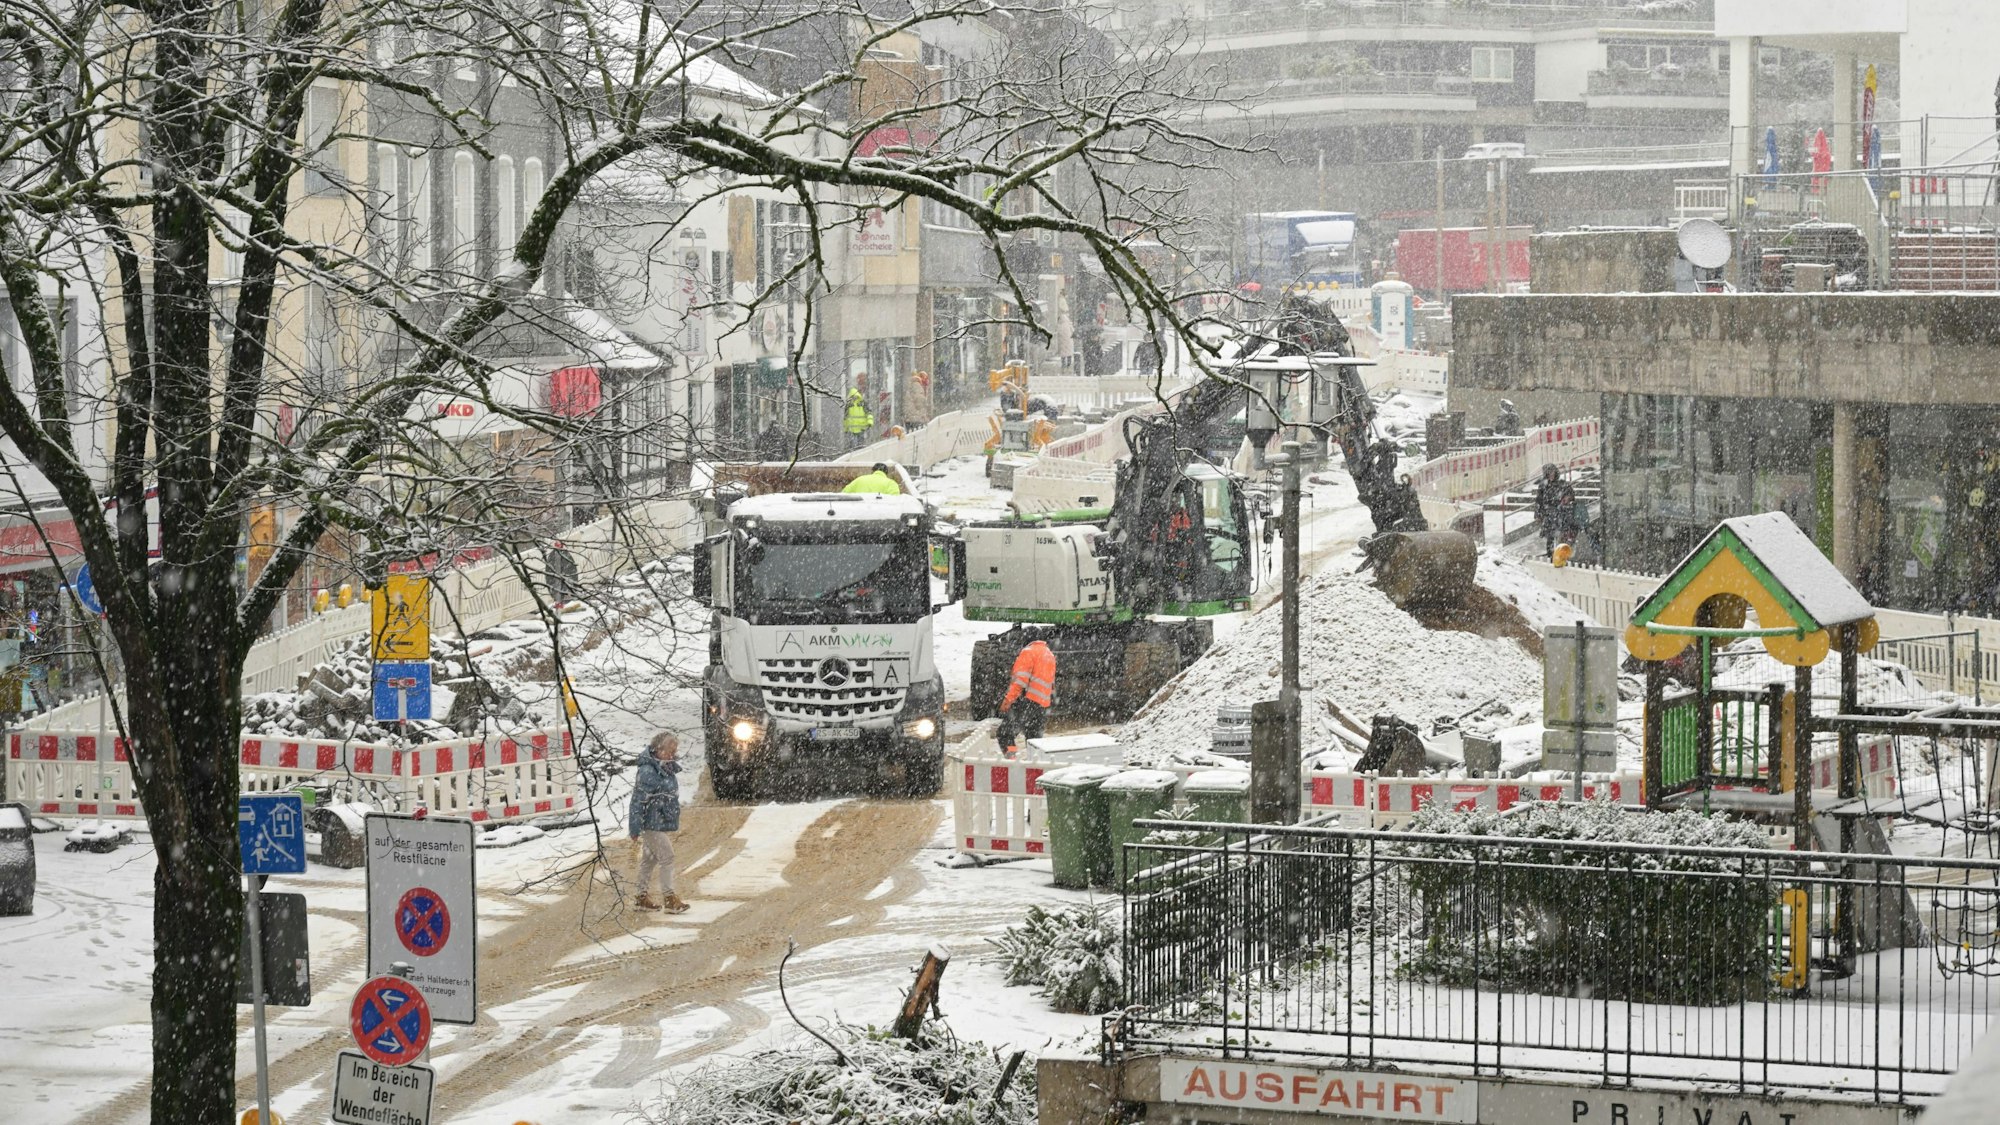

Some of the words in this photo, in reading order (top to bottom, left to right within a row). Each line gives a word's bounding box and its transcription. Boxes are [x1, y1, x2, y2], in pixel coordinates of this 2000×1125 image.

[437, 403, 475, 417] NKD
[809, 635, 840, 646] AKM
[883, 662, 900, 684] A
[374, 837, 390, 847] auf
[395, 837, 411, 847] der
[416, 841, 465, 852] gesamten
[393, 852, 447, 866] Restfläche
[352, 1061, 368, 1079] Im
[371, 1065, 419, 1090] Bereich
[373, 1086, 395, 1104] der
[1183, 1068, 1454, 1115] AUSFAHRT
[340, 1098, 422, 1125] Wendefläche
